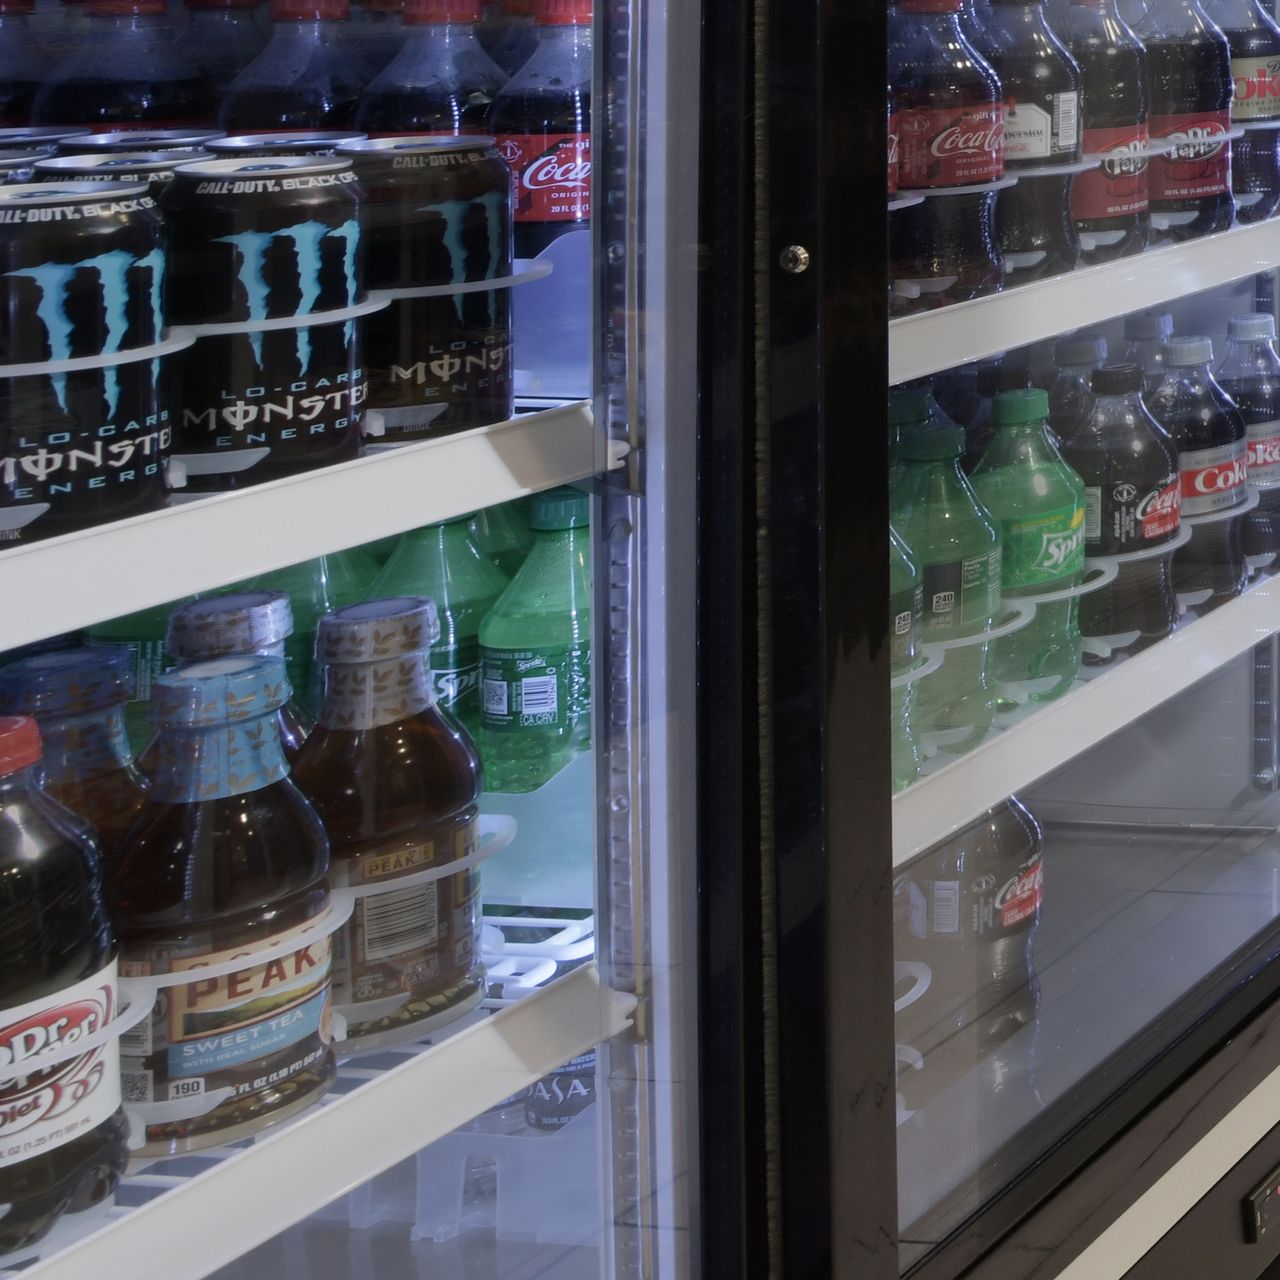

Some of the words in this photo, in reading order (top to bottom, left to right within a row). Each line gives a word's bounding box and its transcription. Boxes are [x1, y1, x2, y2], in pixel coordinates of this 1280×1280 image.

[283, 173, 336, 190] BLACK
[84, 198, 140, 217] BLACK
[561, 204, 568, 212] FL
[222, 368, 362, 399] LO-CARB
[19, 410, 169, 447] LO-CARB
[216, 413, 364, 446] ENERGY
[14, 457, 169, 499] ENERGY
[935, 594, 953, 605] 240
[517, 657, 546, 672] Sprite
[522, 713, 535, 724] CA
[186, 944, 316, 1008] PEAK
[182, 1026, 262, 1056] SWEET
[269, 1010, 305, 1031] TEA
[217, 1048, 247, 1064] REAL
[251, 1033, 286, 1050] SUGAR
[173, 1080, 200, 1095] 190
[239, 1081, 253, 1093] FL
[254, 1075, 267, 1088] OZ
[528, 1076, 592, 1105] ASA
